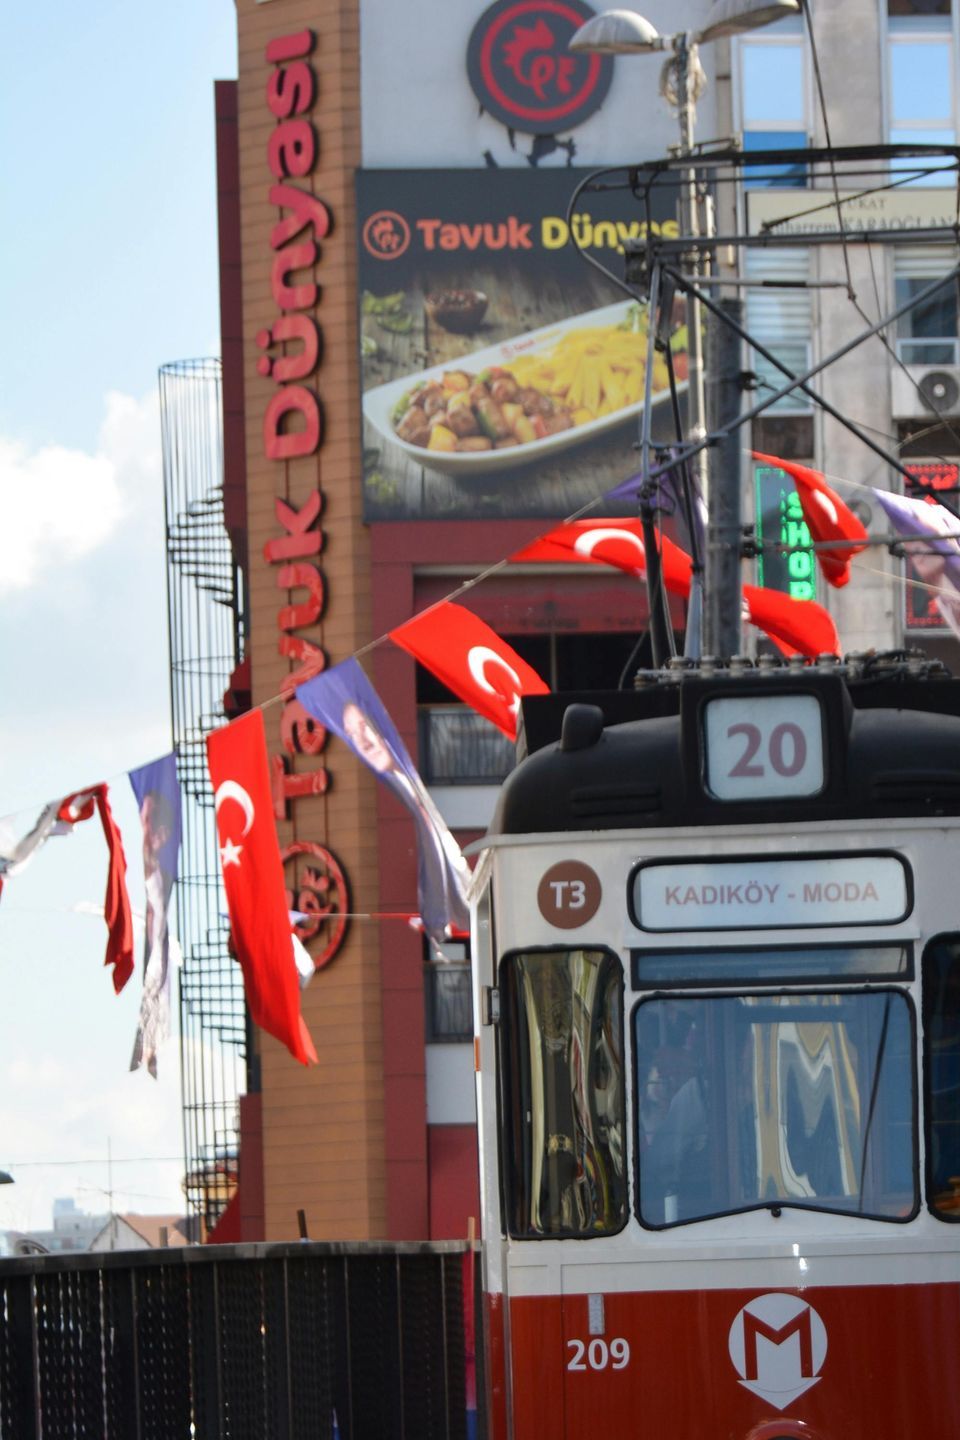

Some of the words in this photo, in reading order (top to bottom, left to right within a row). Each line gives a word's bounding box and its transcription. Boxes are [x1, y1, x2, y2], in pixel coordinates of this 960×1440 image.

[256, 28, 332, 460] Dünyası
[417, 216, 533, 250] Tavuk
[541, 213, 681, 255] Dünyas
[262, 488, 331, 821] Tavuk
[726, 722, 807, 778] 20
[550, 880, 586, 909] T3
[664, 880, 781, 906] KADIKÖY
[803, 881, 879, 902] MODA
[567, 1337, 630, 1371] 209
